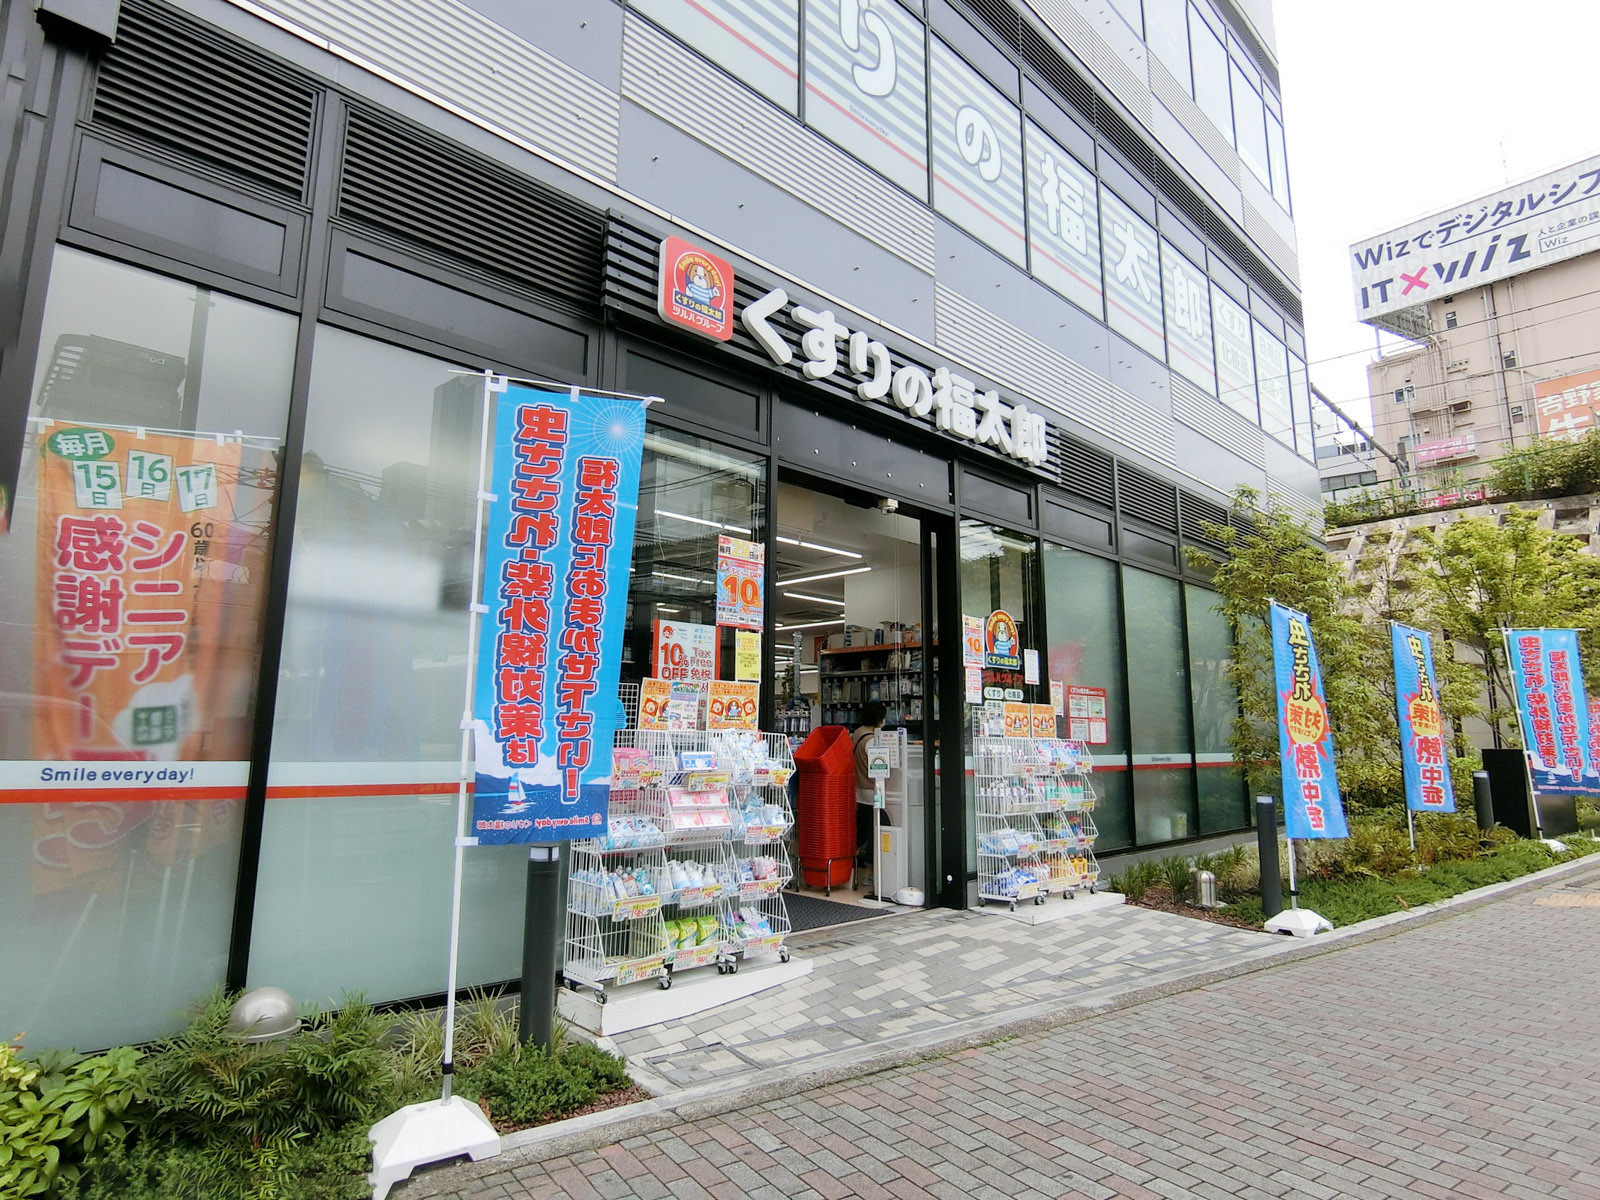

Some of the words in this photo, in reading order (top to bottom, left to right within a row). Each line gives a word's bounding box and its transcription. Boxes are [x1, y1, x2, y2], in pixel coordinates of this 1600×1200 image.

[1544, 237, 1568, 249] Wiz
[672, 305, 725, 333] ツルハグループ
[675, 294, 722, 320] くすりの福太郎
[742, 287, 1048, 467] くすりの福太郎
[55, 433, 110, 458] 毎月
[76, 465, 117, 491] 15
[132, 455, 168, 482] 16
[180, 468, 215, 493] 17
[129, 521, 187, 683] シニア
[55, 516, 125, 738] 感謝デー
[690, 656, 713, 668] Free
[692, 646, 712, 659] Tax
[661, 666, 688, 680] OFF
[40, 767, 97, 782] Smile
[101, 770, 154, 784] every
[156, 767, 195, 783] day!
